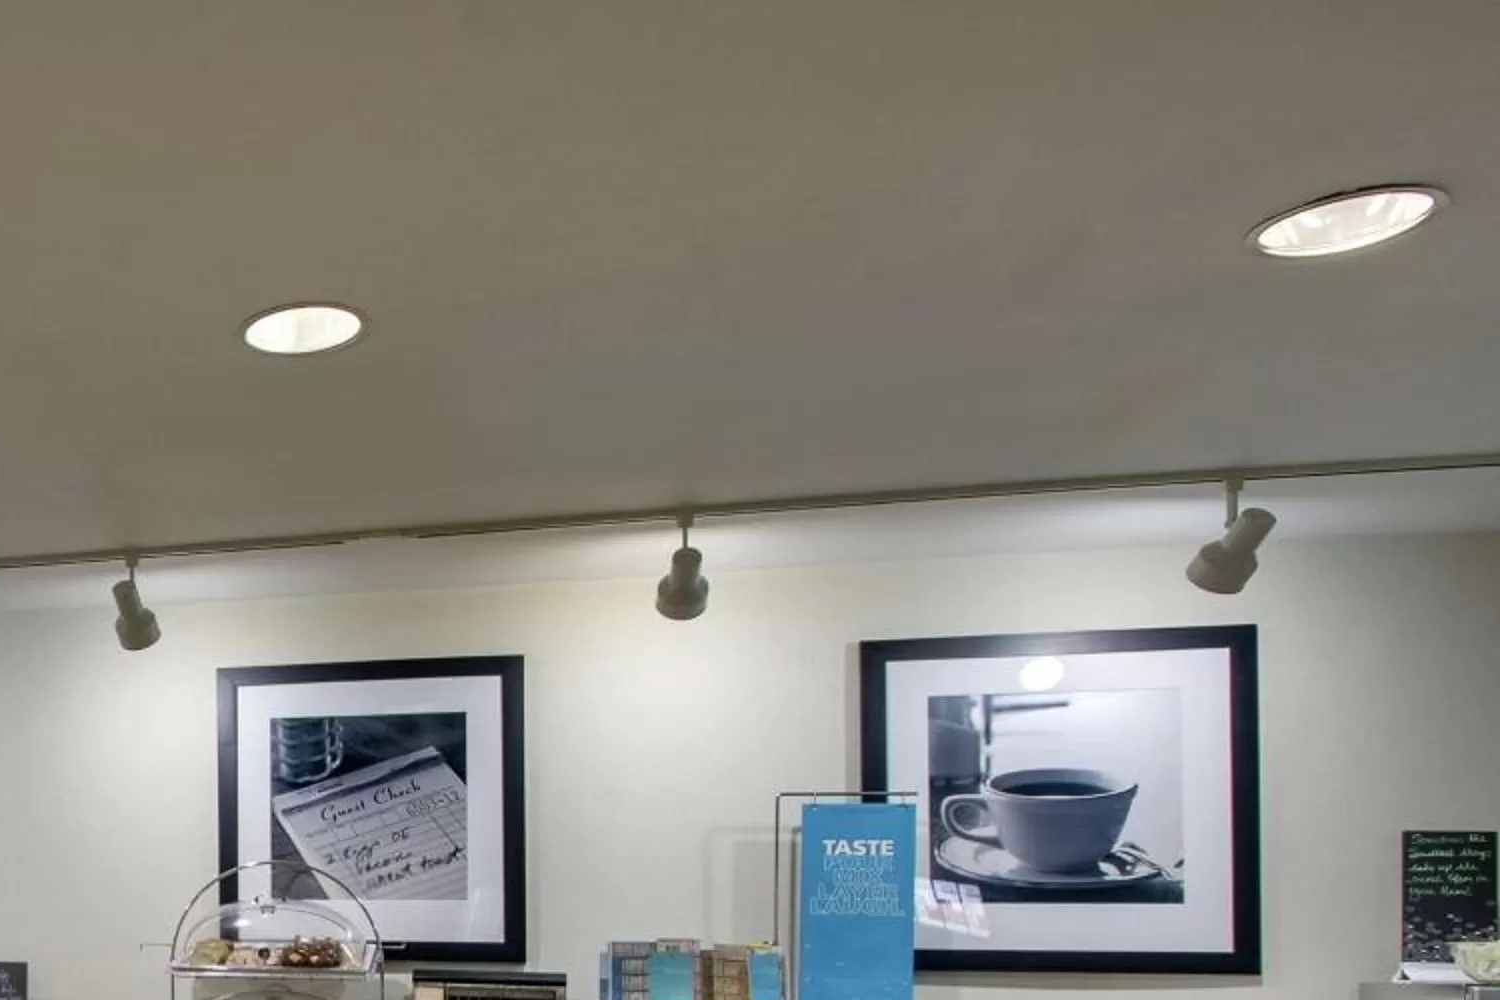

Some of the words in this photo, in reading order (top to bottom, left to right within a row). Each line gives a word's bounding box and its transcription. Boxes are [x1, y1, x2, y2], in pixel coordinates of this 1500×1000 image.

[321, 801, 366, 822] Guest
[374, 779, 421, 805] Check
[821, 839, 896, 856] TASTE
